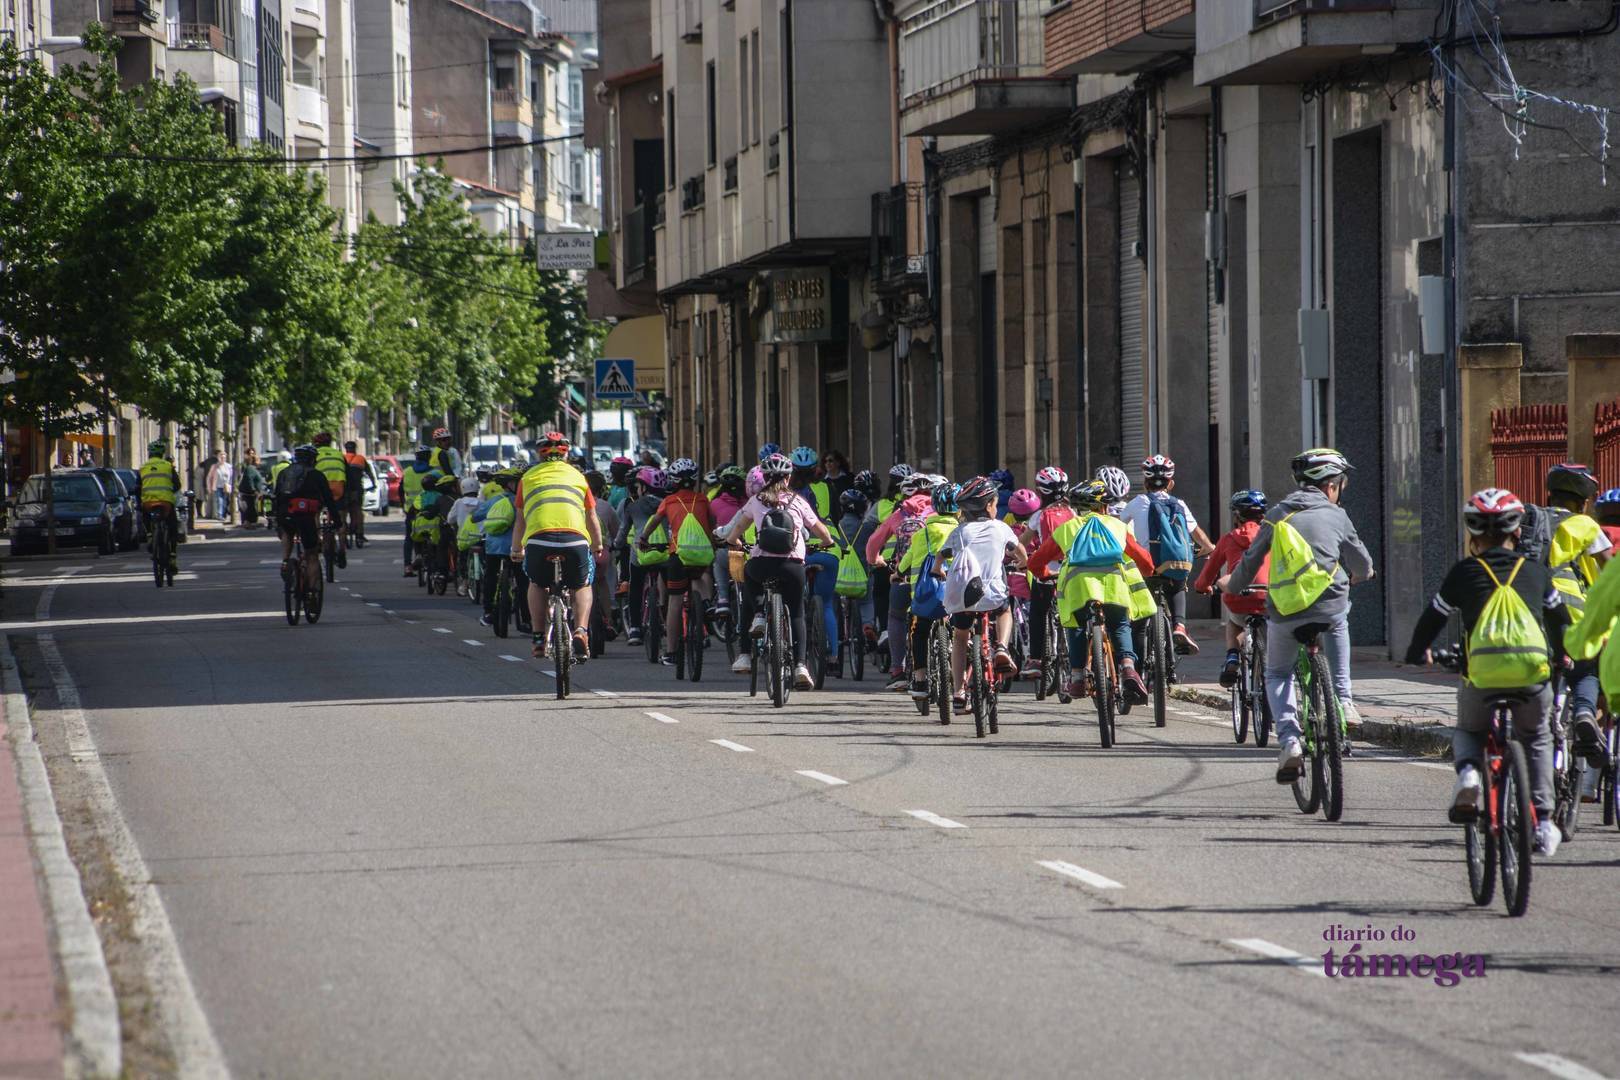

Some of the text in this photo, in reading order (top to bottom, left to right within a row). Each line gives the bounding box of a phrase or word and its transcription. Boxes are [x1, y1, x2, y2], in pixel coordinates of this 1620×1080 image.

[556, 237, 592, 248] La Paz
[540, 252, 592, 261] FUNERARIA
[540, 260, 592, 269] TANATORIO
